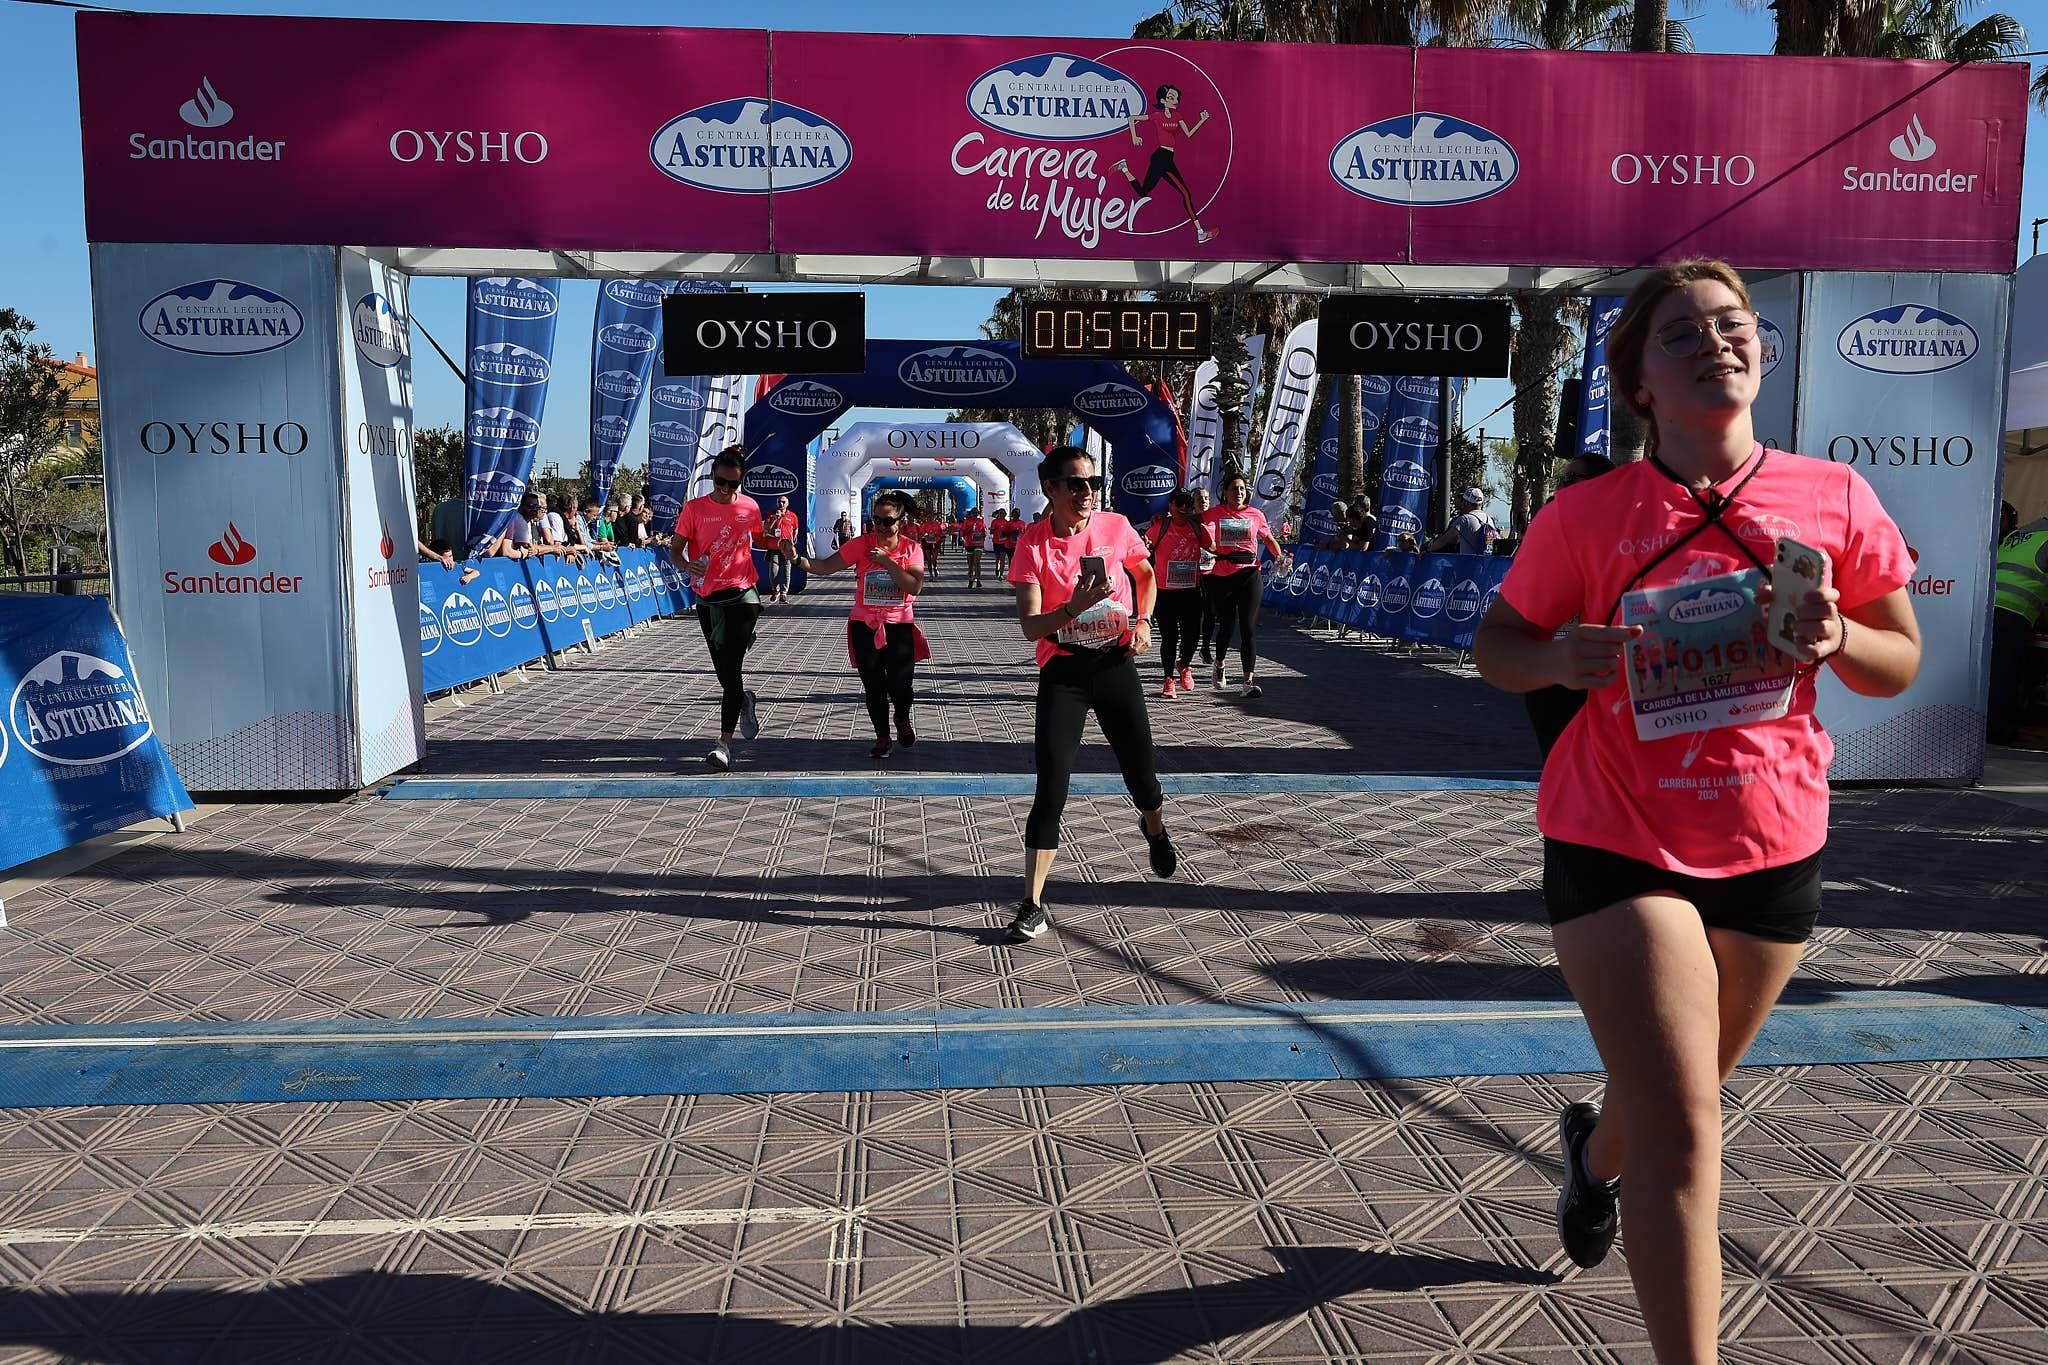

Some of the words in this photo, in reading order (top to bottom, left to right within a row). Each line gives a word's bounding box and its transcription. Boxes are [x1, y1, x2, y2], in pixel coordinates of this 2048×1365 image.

[1009, 82, 1065, 93] CENTRAL
[1071, 84, 1128, 94] LECHERA
[980, 83, 1132, 119] ASTURIANA
[128, 133, 286, 161] Santander
[389, 129, 549, 163] OYSHO
[696, 130, 761, 141] CENTRAL
[666, 132, 837, 169] ASTURIANA
[951, 131, 1098, 180] Carrera
[1373, 144, 1433, 154] CENTRAL
[1438, 145, 1499, 155] LECHERA
[1344, 145, 1504, 182] ASTURIANA
[1610, 152, 1755, 186] OYSHO
[1842, 165, 1978, 193] Santander
[987, 179, 1015, 210] de
[1020, 179, 1040, 211] la
[1034, 175, 1153, 249] Mujer
[475, 287, 552, 313] ASTURIANA
[610, 284, 662, 304] ASTURIANA
[176, 305, 229, 314] CENTRAL
[233, 306, 286, 315] LECHERA
[152, 307, 292, 337] ASTURIANA
[1035, 310, 1198, 350] 00:59:02
[1869, 328, 1914, 336] CENTRAL
[603, 330, 652, 349] ASTURIANA
[696, 319, 837, 349] OYSHO
[1349, 321, 1483, 351] OYSHO
[1846, 329, 1968, 357] ASTURIANA
[470, 354, 545, 379] ASTURIANA
[906, 360, 1008, 383] ASTURIANA
[655, 389, 700, 409] ASTURIANA
[773, 392, 837, 407] ASTURIANA
[1400, 379, 1440, 397] ASTURIA
[1080, 396, 1143, 409] ASTURIANA
[650, 426, 694, 443] ASTURIANA
[1189, 384, 1220, 484] YSHO
[1256, 346, 1317, 501] OYSHO
[140, 421, 309, 455] OYSHO
[358, 422, 409, 459] OYSHO
[887, 429, 980, 449] OYSHO
[831, 450, 860, 458] OYSHO
[1828, 435, 1974, 467] OYSHO
[652, 466, 688, 479] STURIANA
[744, 475, 795, 489] ASTURIANA
[1125, 477, 1175, 490] ASTURIANA
[819, 488, 846, 496] OYSHO
[1020, 488, 1042, 496] OYSH
[164, 571, 303, 594] Santander
[367, 566, 408, 591] Santander
[1673, 598, 1741, 621] ASTURIANA
[445, 613, 480, 635] ASTURIANA
[1682, 639, 1749, 673] 016
[1702, 672, 1732, 689] 1627
[39, 689, 85, 706] CENTRAL
[1641, 694, 1683, 712] CARRERA
[1685, 692, 1697, 704] DE
[1699, 690, 1713, 702] LA
[1714, 684, 1747, 700] MUJER
[1742, 700, 1780, 715] Santan
[26, 696, 149, 745] ASTURIANA
[1654, 709, 1708, 730] OYSHO
[1658, 777, 1698, 790] CARRERA
[1700, 777, 1711, 788] DE
[1713, 777, 1725, 788] LA
[1697, 790, 1719, 801] 2024
